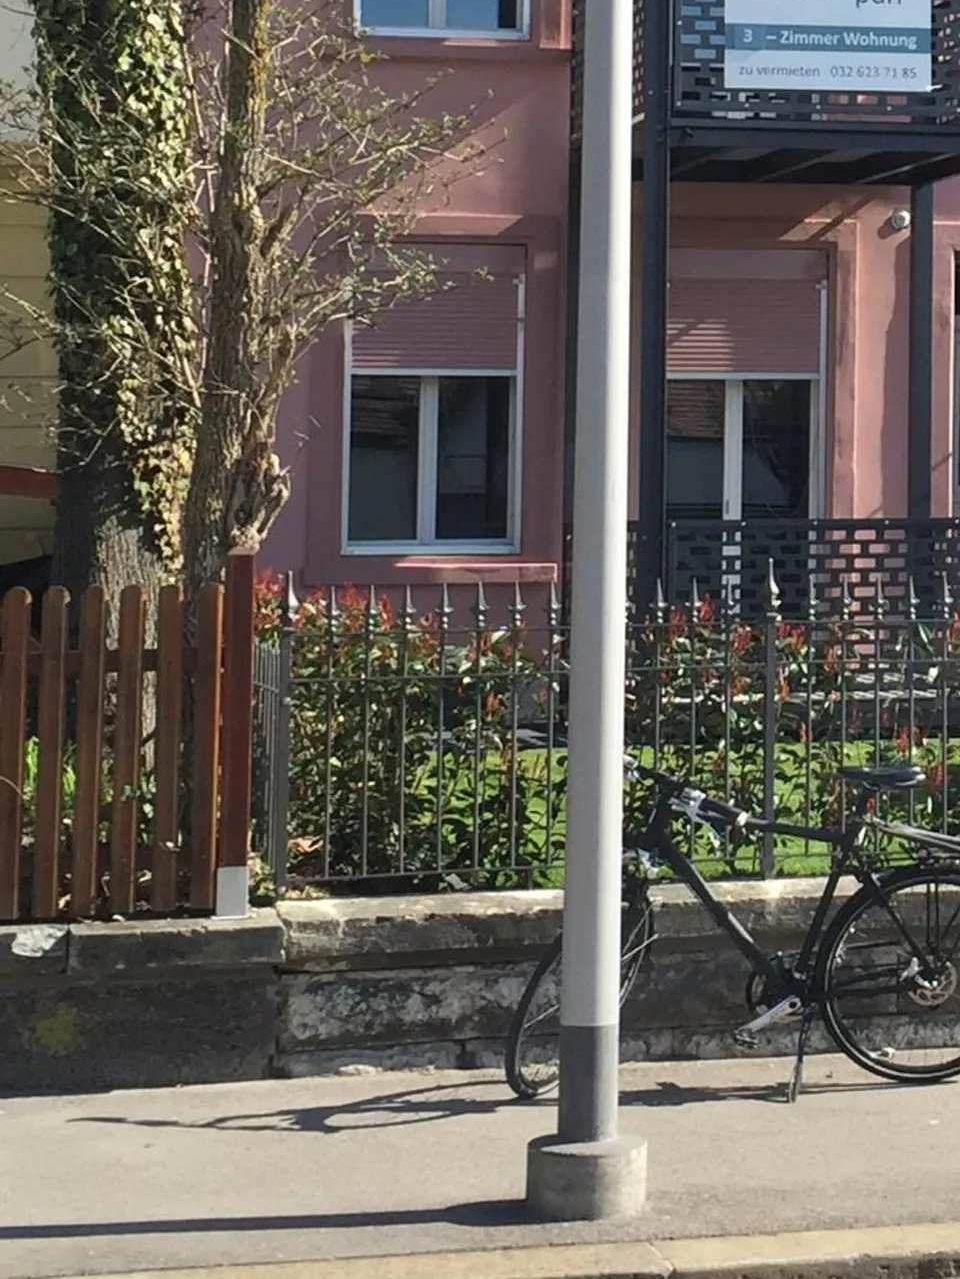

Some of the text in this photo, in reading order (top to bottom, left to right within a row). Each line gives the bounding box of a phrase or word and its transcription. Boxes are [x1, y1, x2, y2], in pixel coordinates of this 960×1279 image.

[743, 29, 753, 43] 3
[780, 30, 840, 46] Zimmer
[844, 32, 918, 50] Wohnung
[739, 65, 918, 80] zu vermieten 032 623 71 85
